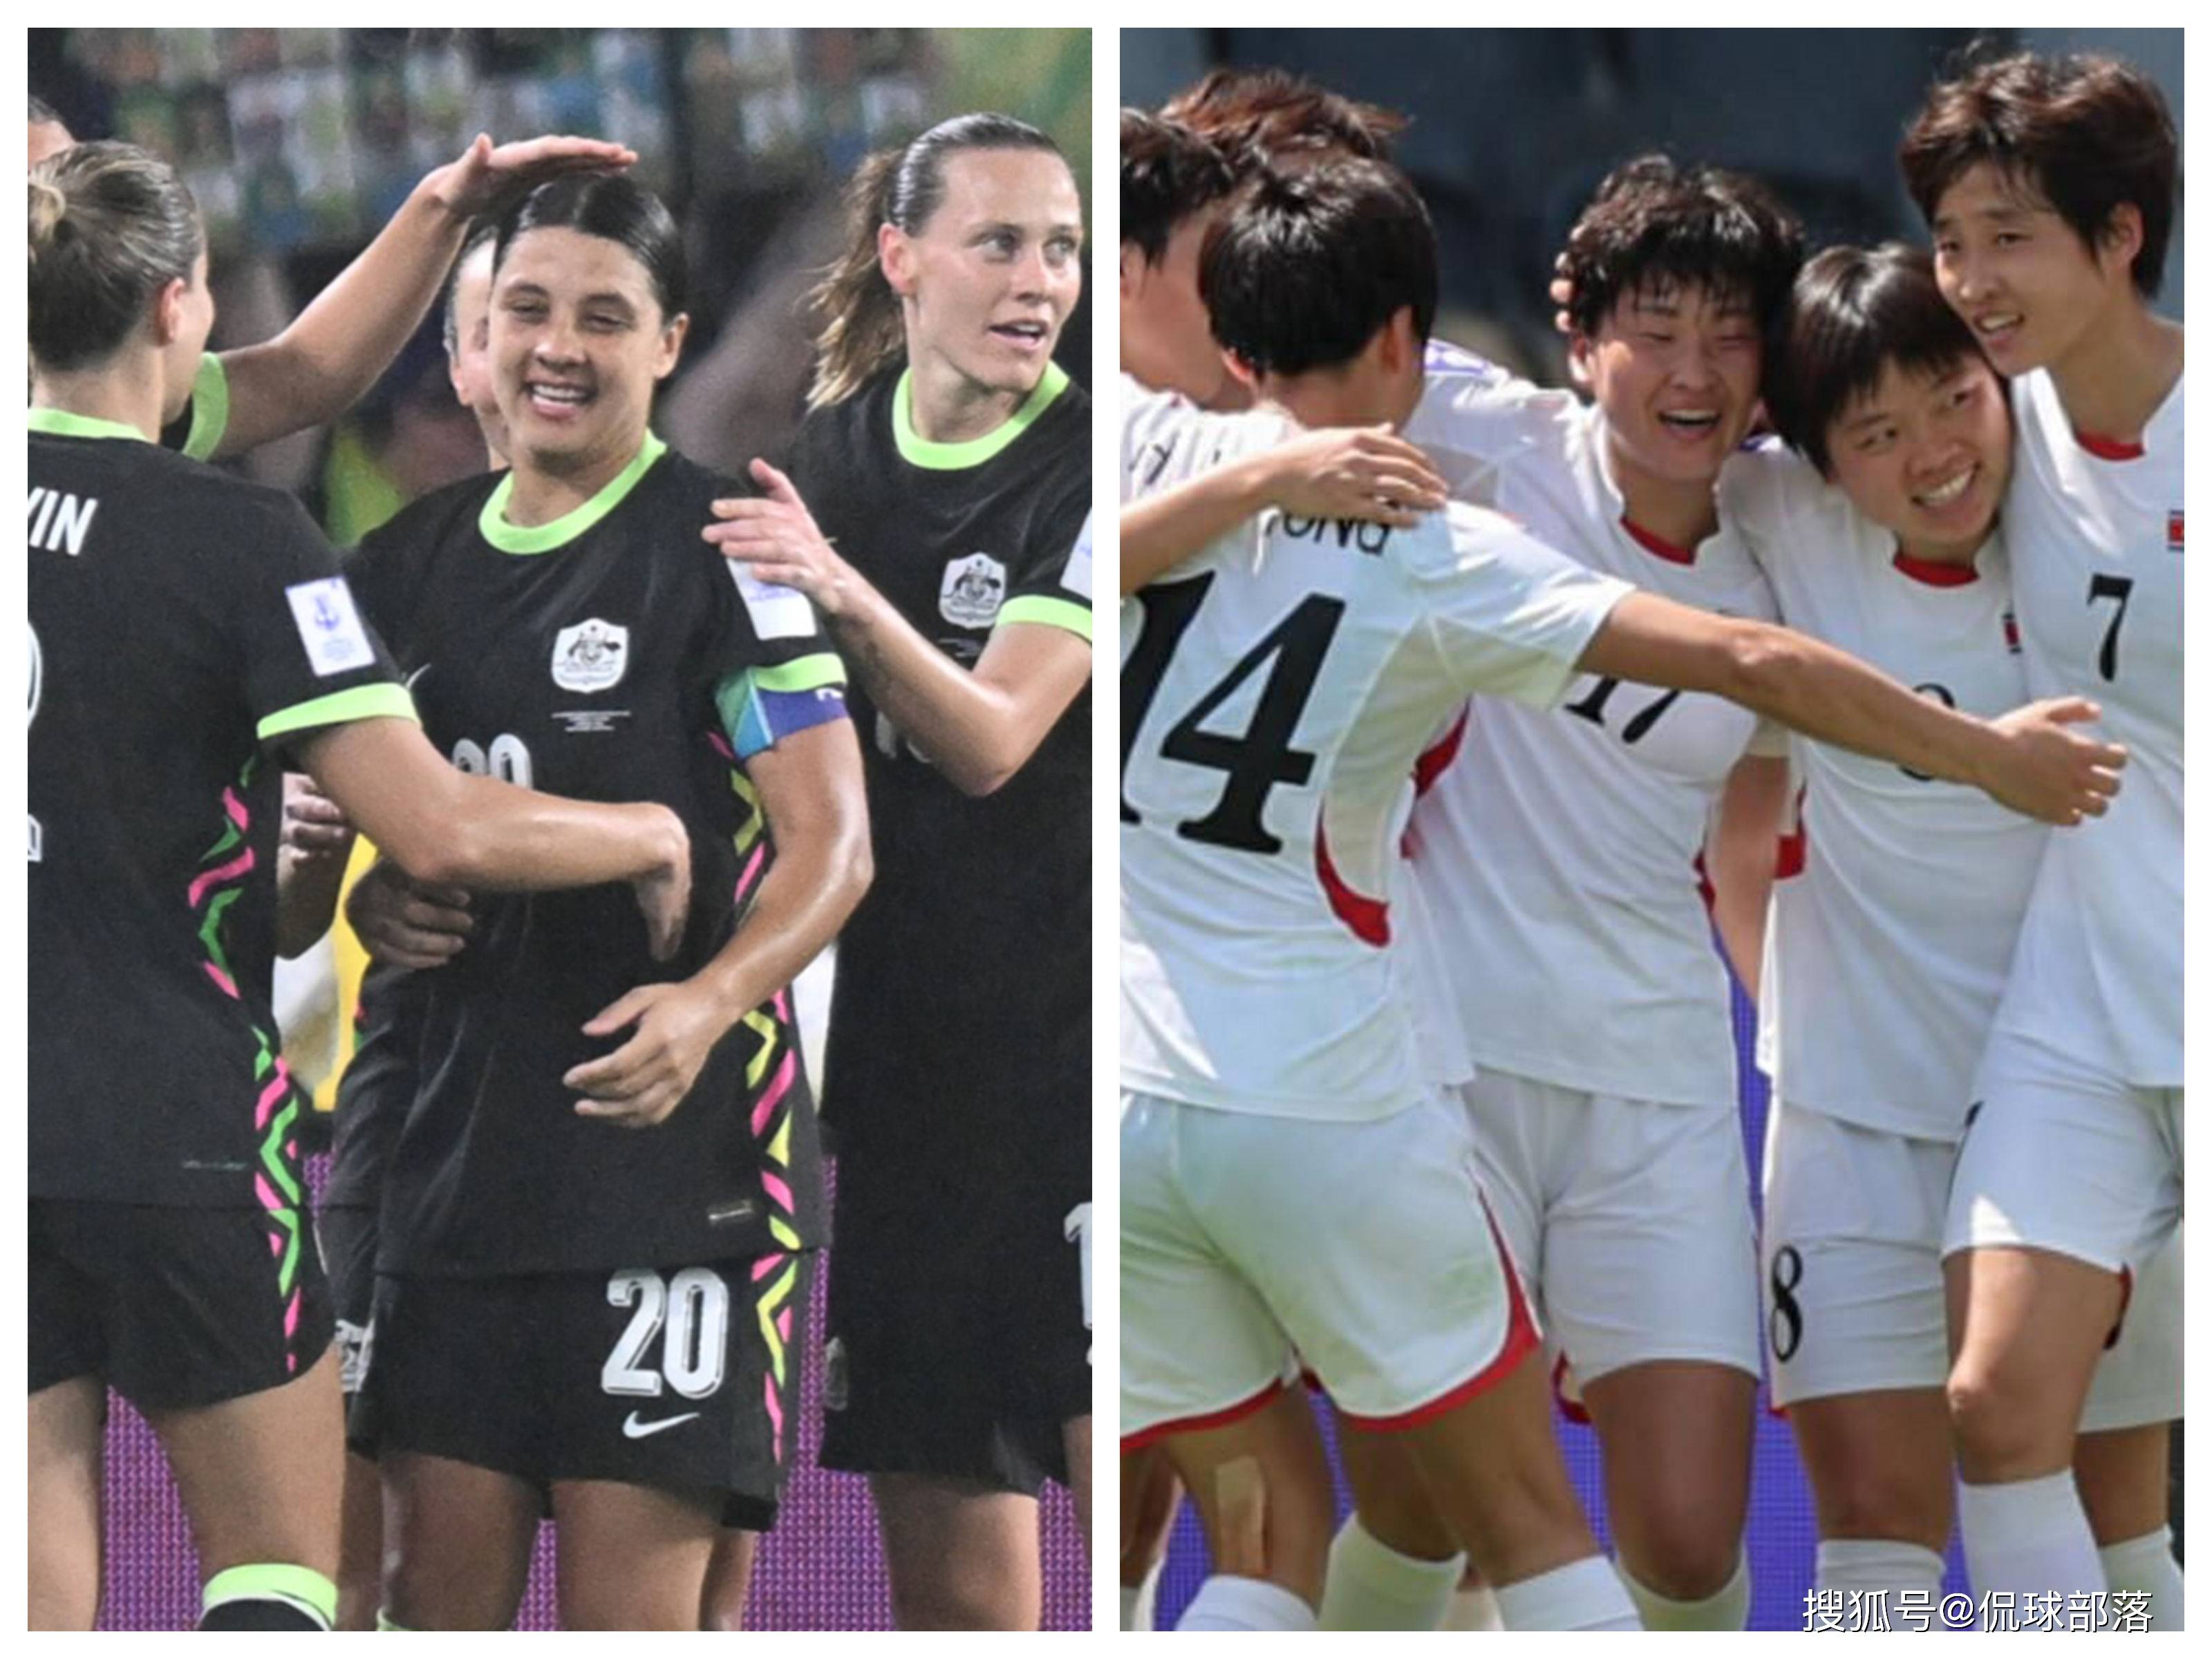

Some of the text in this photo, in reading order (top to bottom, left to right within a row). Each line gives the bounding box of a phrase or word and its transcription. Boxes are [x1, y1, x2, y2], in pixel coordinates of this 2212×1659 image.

[2087, 573, 2134, 682] 7
[1120, 570, 1346, 854] 14
[601, 1266, 729, 1400] 20
[1770, 1246, 1802, 1362] 8
